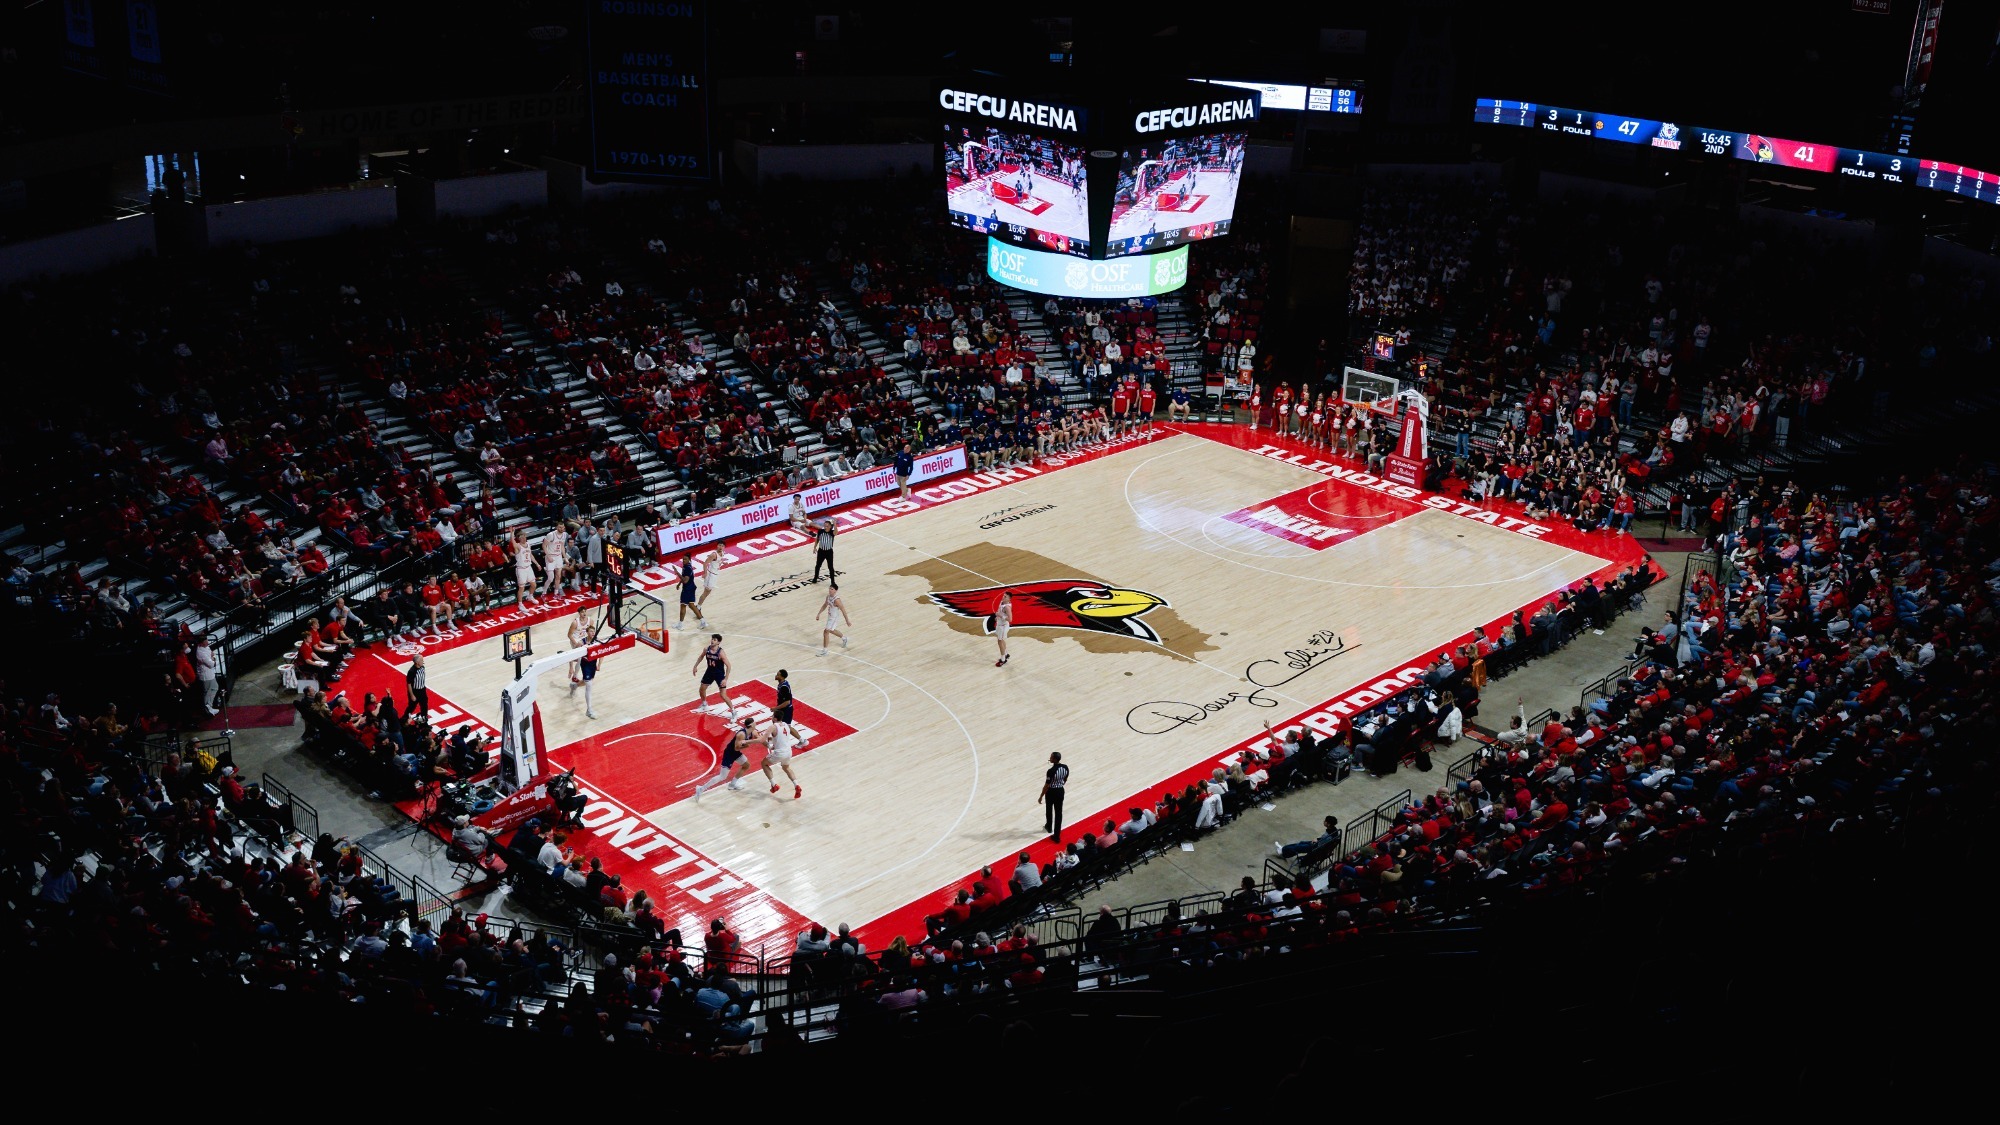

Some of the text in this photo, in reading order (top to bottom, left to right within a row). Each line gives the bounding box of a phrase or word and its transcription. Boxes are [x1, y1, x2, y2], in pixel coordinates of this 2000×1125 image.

[602, 0, 693, 17] ROBINSON
[622, 52, 673, 67] MEN'S
[598, 71, 699, 88] BASKETBALL
[621, 92, 677, 107] COACH
[1519, 102, 1529, 110] 14
[320, 110, 398, 136] HOME
[410, 106, 443, 128] OF
[453, 102, 498, 123] THE
[940, 89, 1077, 132] CEFCU ARENA
[1135, 98, 1254, 133] CEFCU ARENA
[1548, 110, 1582, 124] 3 1
[1542, 122, 1592, 136] TOL FOULS
[1618, 120, 1640, 136] 47
[1651, 137, 1682, 150] BELMONT
[1700, 132, 1732, 147] 16:45
[1704, 144, 1725, 155] 2ND
[1794, 146, 1814, 163] 41
[610, 151, 697, 168] 1970-1975
[1856, 153, 1902, 171] 1 3
[1841, 167, 1903, 183] FOULS TOL
[1931, 161, 1985, 180] 3 4 11
[1930, 171, 1983, 189] 0 5 8
[1929, 180, 1934, 188] 1
[1953, 184, 1960, 193] 2
[1975, 190, 1979, 198] 1
[989, 223, 998, 231] 47
[1008, 223, 1027, 235] 16:45
[1163, 230, 1180, 240] 16:45
[1188, 229, 1196, 237] 41
[1037, 234, 1046, 243] 41
[1070, 239, 1074, 247] 3
[1145, 237, 1154, 245] 47
[1000, 250, 1024, 273] OSF
[1091, 263, 1130, 282] OSF
[1057, 450, 1086, 460] OSF
[922, 455, 953, 475] meijer
[1250, 444, 1422, 499] ILLINOIS
[805, 487, 841, 508] meijer
[741, 499, 779, 526] meijer
[980, 503, 1057, 531] CEFCU ARENA
[1422, 495, 1553, 540] STATE
[737, 498, 919, 555] COLINS
[1249, 505, 1354, 541] VALLEY
[674, 521, 715, 544] meijer
[751, 582, 800, 602] CEFCU
[420, 630, 464, 646] OSF
[1126, 687, 1278, 735] Doug
[1306, 629, 1336, 647] #20
[782, 728, 788, 736] 4
[571, 786, 744, 905] ILLINO
